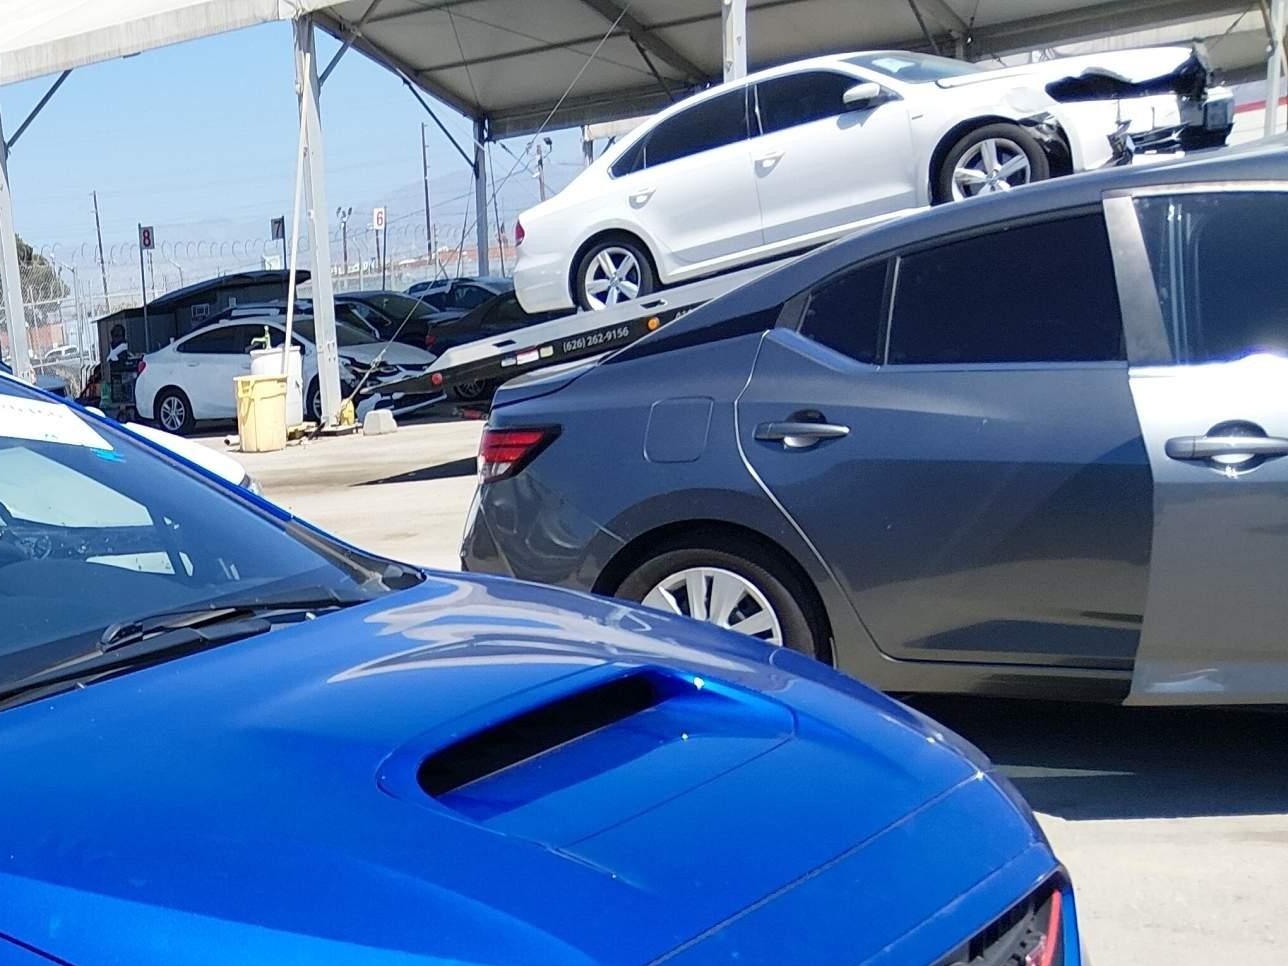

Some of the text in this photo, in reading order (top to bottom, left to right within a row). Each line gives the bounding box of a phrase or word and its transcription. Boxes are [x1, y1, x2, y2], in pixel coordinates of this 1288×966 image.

[376, 211, 384, 226] 6
[273, 220, 281, 236] 7
[142, 229, 151, 247] 8
[563, 326, 630, 352] (626) 262-9156
